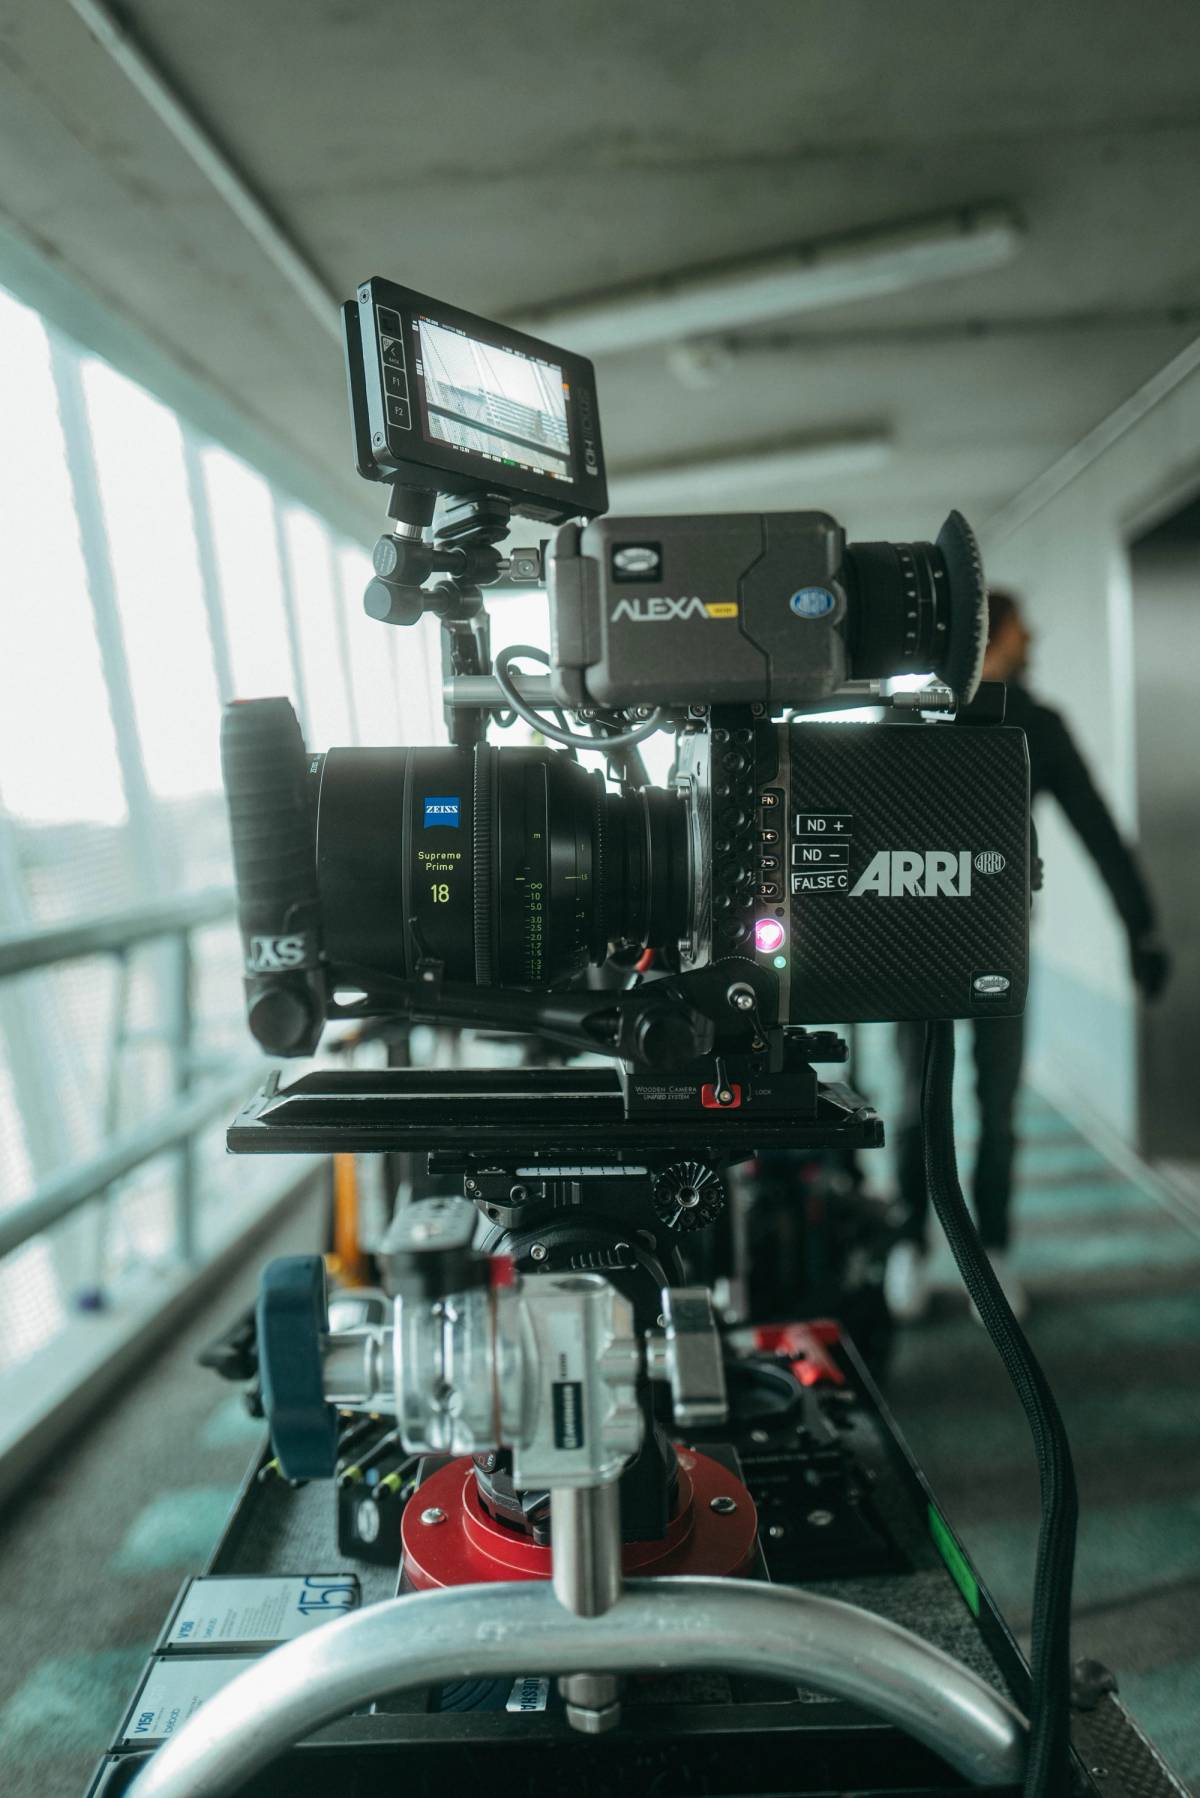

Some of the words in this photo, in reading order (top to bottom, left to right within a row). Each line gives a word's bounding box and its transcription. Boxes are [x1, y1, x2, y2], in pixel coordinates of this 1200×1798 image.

[392, 376, 401, 386] F1
[394, 406, 404, 416] F2
[610, 597, 709, 622] ALEXA
[761, 797, 774, 805] FN
[426, 805, 458, 814] ZEISS
[807, 819, 826, 831] ND
[418, 851, 461, 861] Supreme
[802, 848, 822, 861] ND
[425, 862, 454, 871] Prime
[848, 850, 972, 897] ARRI
[976, 851, 1003, 873] ARRI
[794, 875, 835, 890] FALSE
[837, 875, 848, 888] C
[430, 884, 450, 903] 18
[531, 892, 541, 901] 10
[530, 902, 542, 911] 5.0
[530, 916, 542, 924] 3.0
[530, 924, 542, 932] 2.5
[530, 933, 542, 941] 2.0
[669, 1085, 697, 1093] CAMERA
[520, 1678, 540, 1710] UESHA
[134, 1711, 155, 1734] V150
